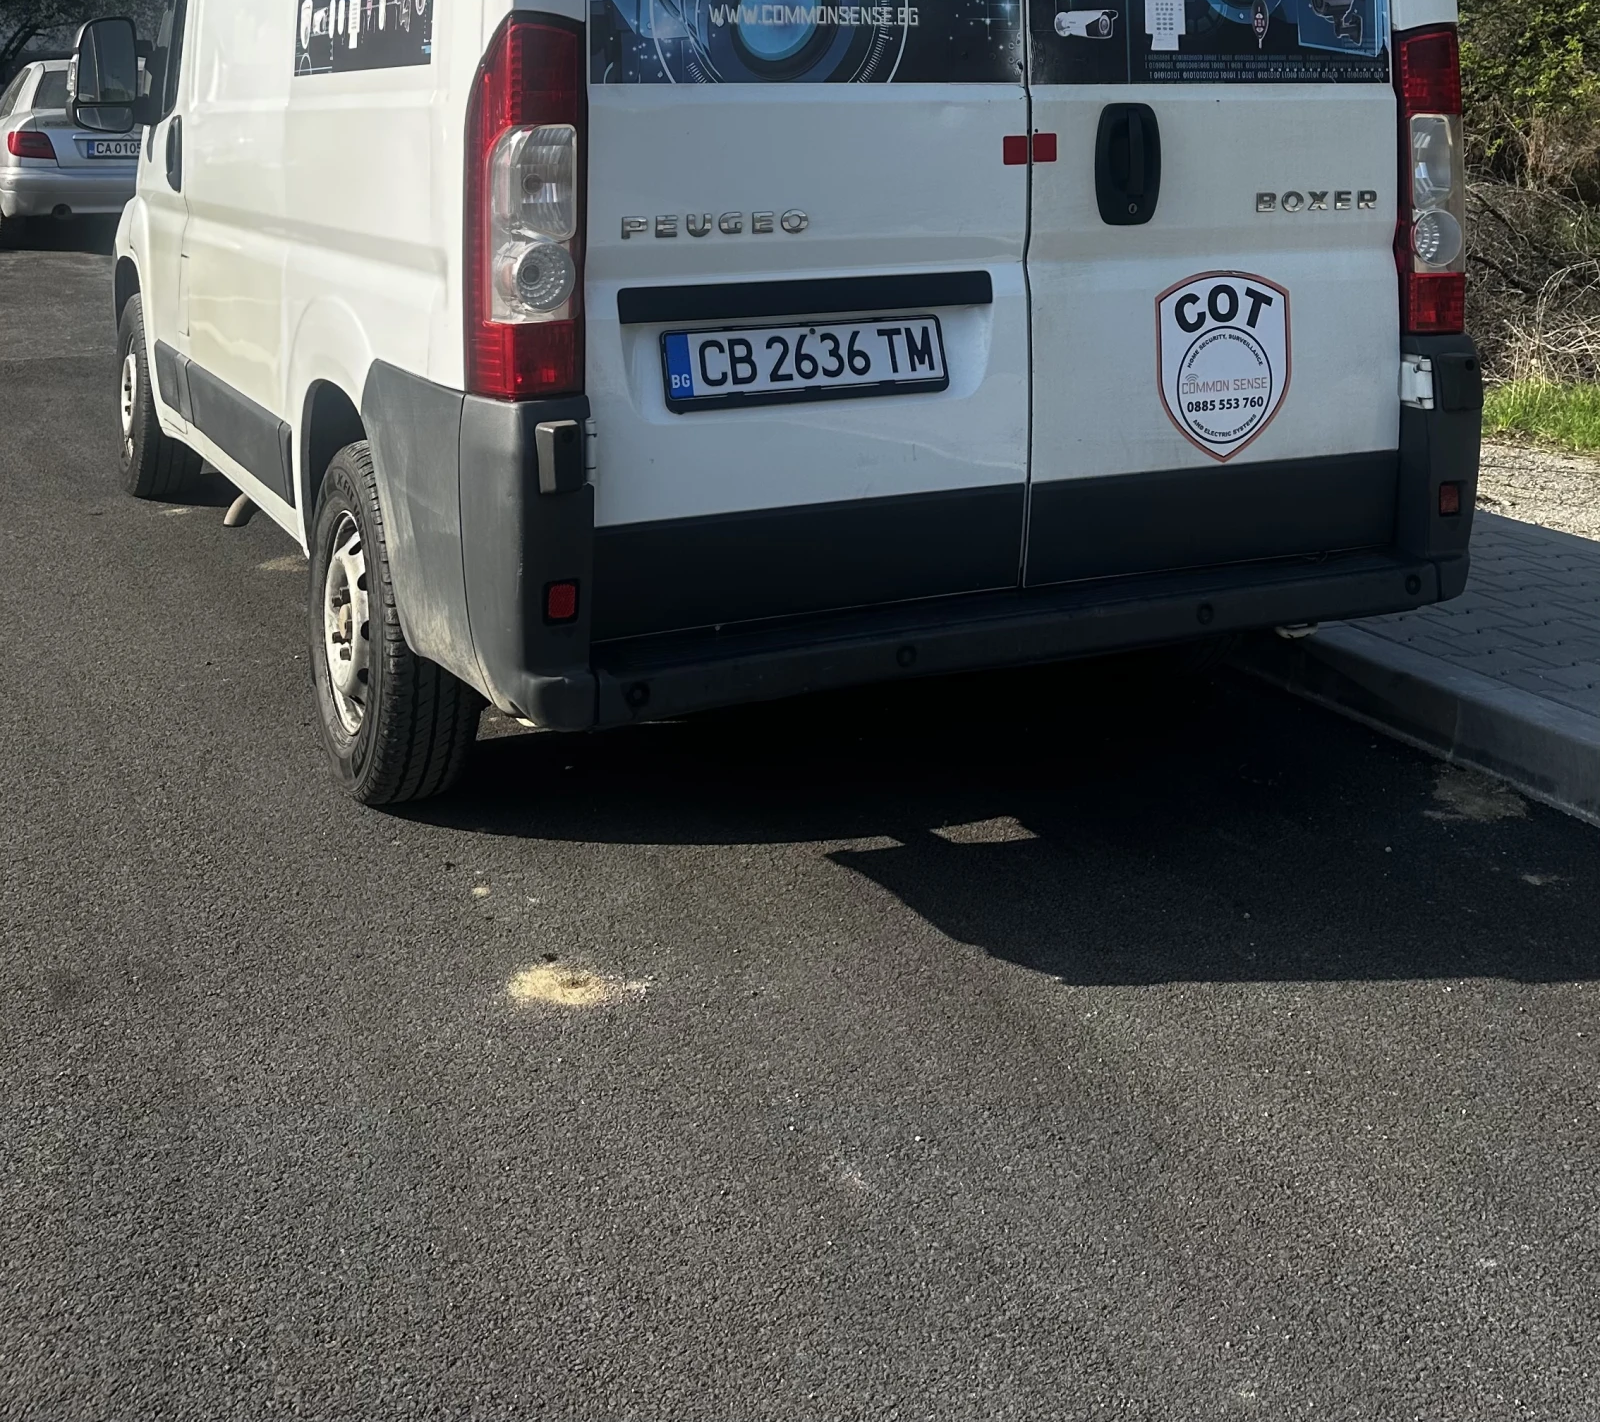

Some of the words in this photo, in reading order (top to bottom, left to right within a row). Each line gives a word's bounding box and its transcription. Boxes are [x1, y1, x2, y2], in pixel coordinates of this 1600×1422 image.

[708, 3, 918, 25] WWW.COMMONSENSE.BG
[96, 143, 112, 154] CA
[1256, 190, 1377, 212] BOXER
[621, 208, 809, 240] PEUGEO
[1174, 284, 1274, 333] COT
[698, 338, 758, 387] CB
[765, 330, 872, 383] 2636
[876, 326, 936, 374] TM
[1187, 349, 1200, 369] HOME
[1228, 334, 1264, 366] SURVEILLANCE
[671, 373, 691, 389] BG
[1181, 380, 1230, 395] COMMON
[1233, 377, 1268, 391] SENSE
[1187, 399, 1216, 413] 0885
[1218, 398, 1240, 411] 553
[1242, 396, 1264, 409] 760
[1192, 419, 1205, 431] AND
[1203, 427, 1232, 438] ELECTRIC
[1232, 414, 1257, 435] SYSTEMS
